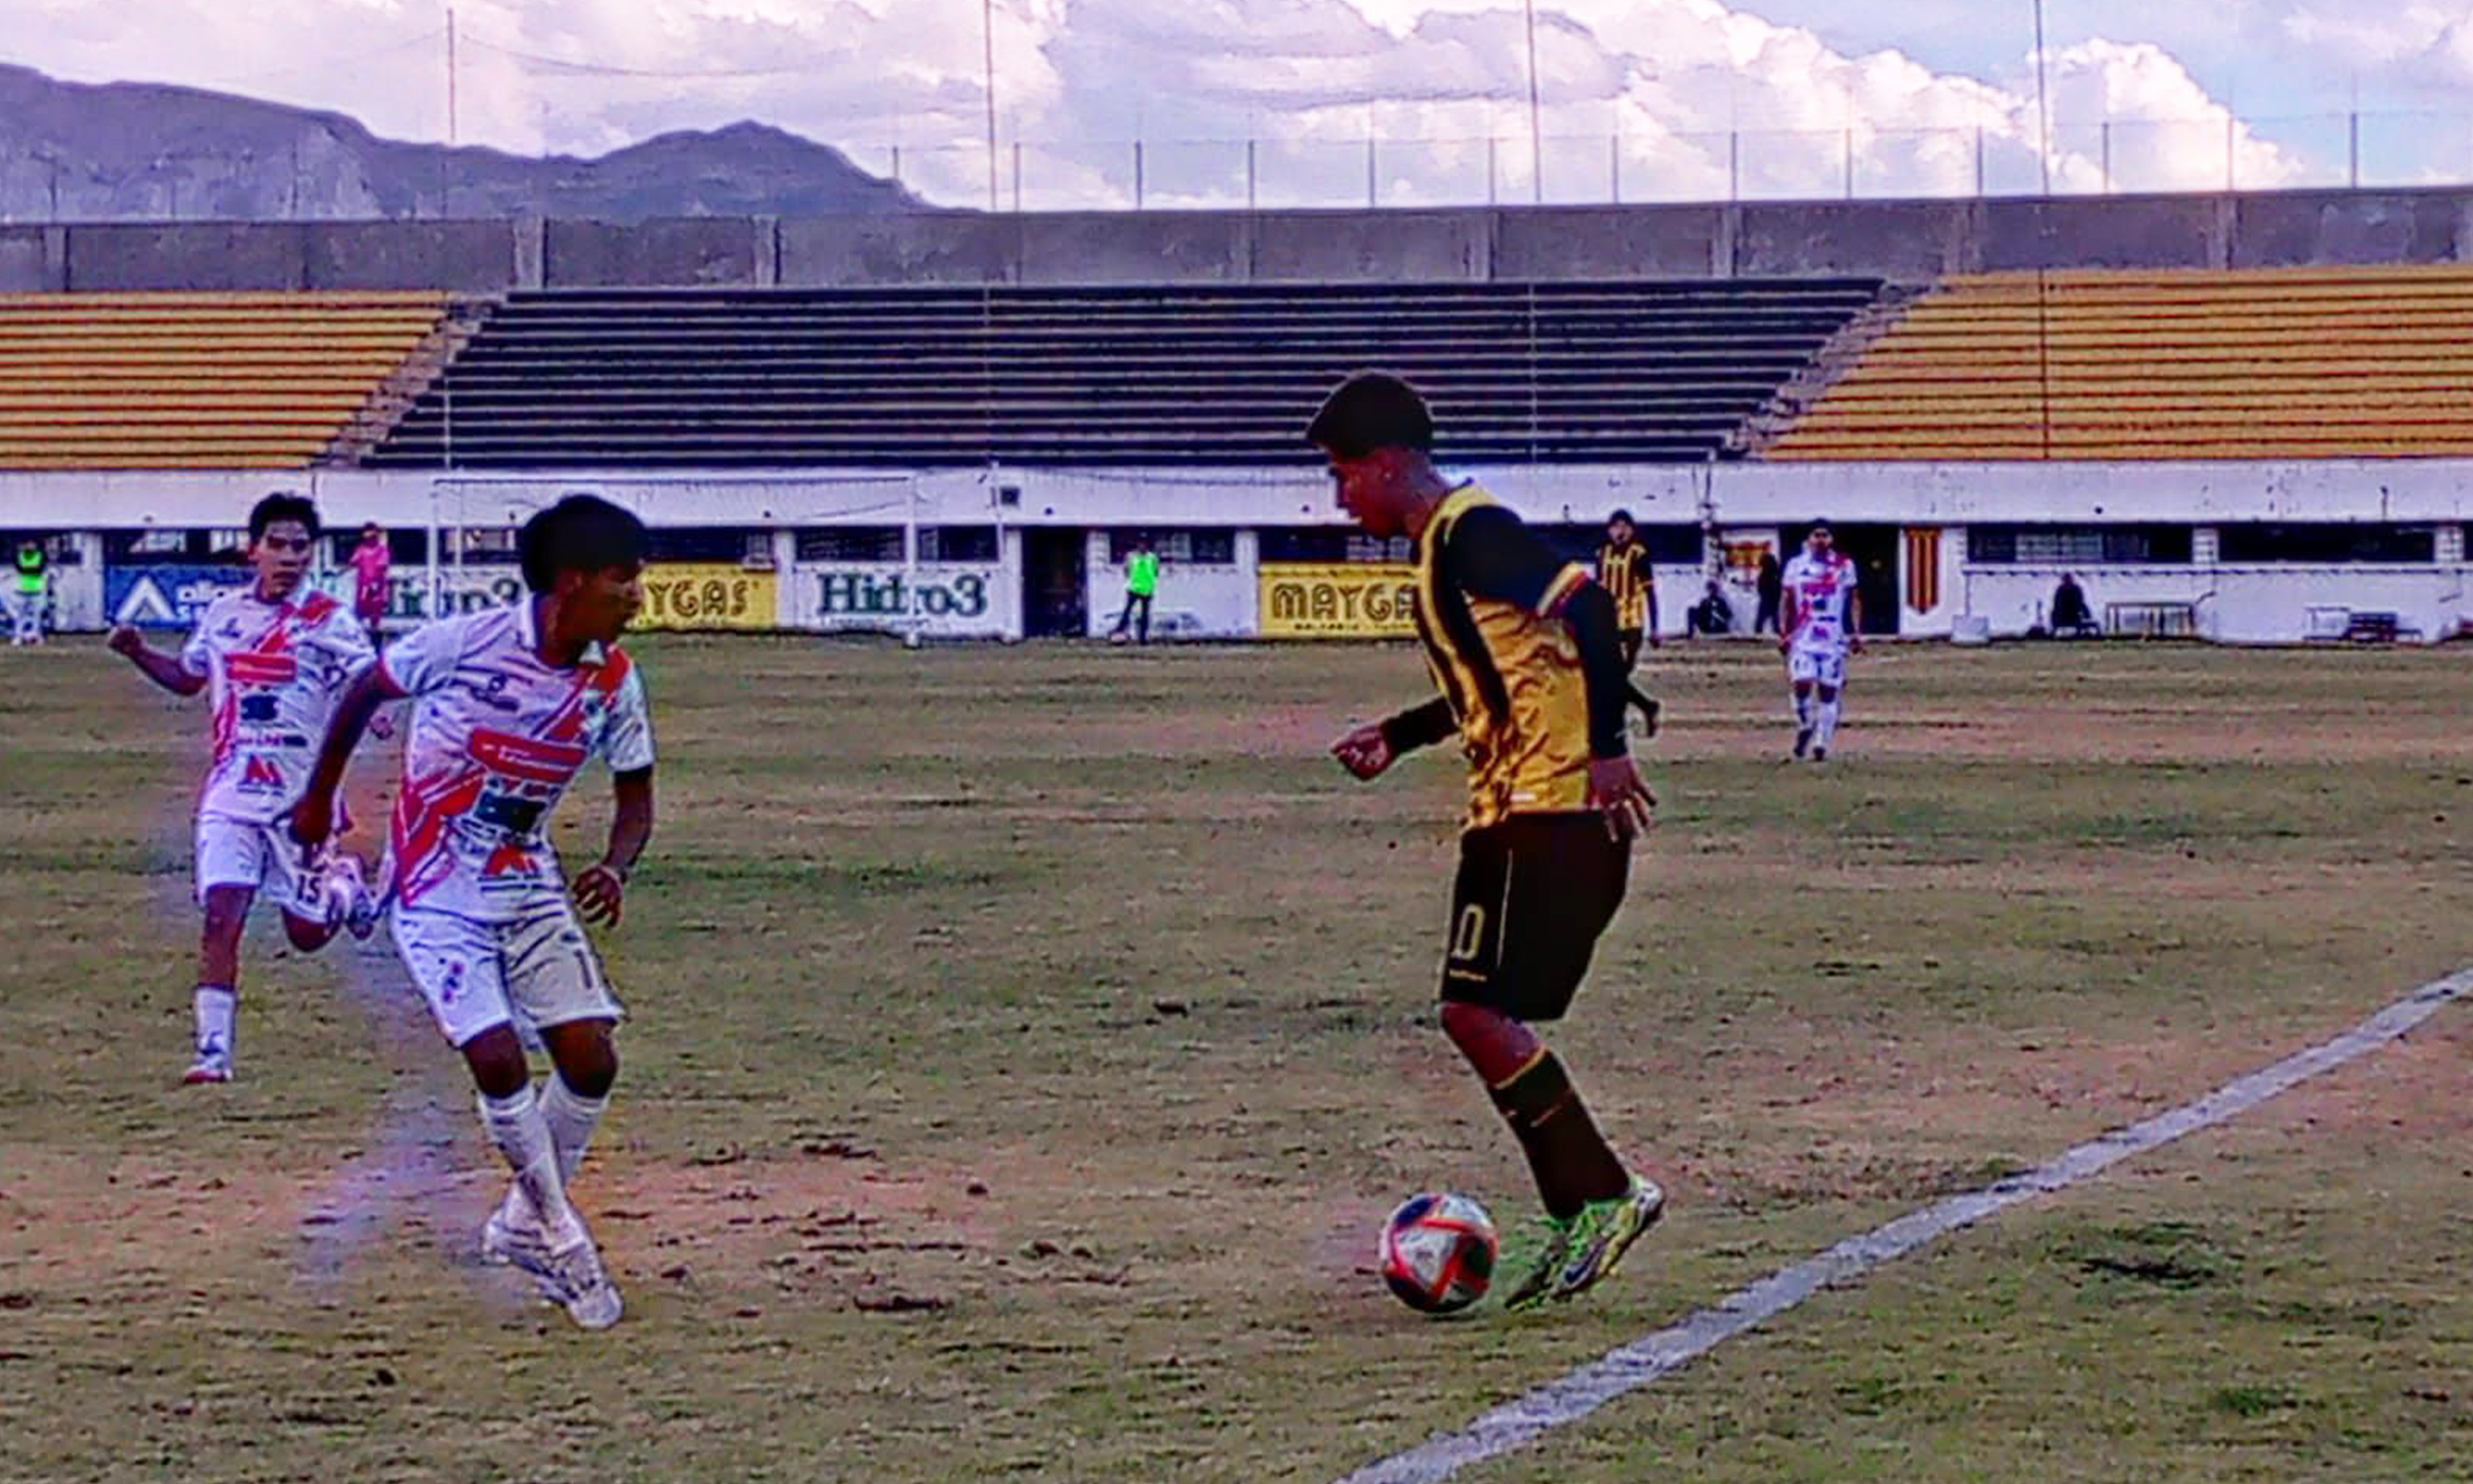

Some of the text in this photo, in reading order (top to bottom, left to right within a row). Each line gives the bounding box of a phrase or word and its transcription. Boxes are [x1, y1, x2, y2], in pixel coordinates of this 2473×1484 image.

[648, 580, 749, 617] YGAS
[817, 573, 987, 617] Hidro3
[1273, 583, 1414, 620] MAYGA
